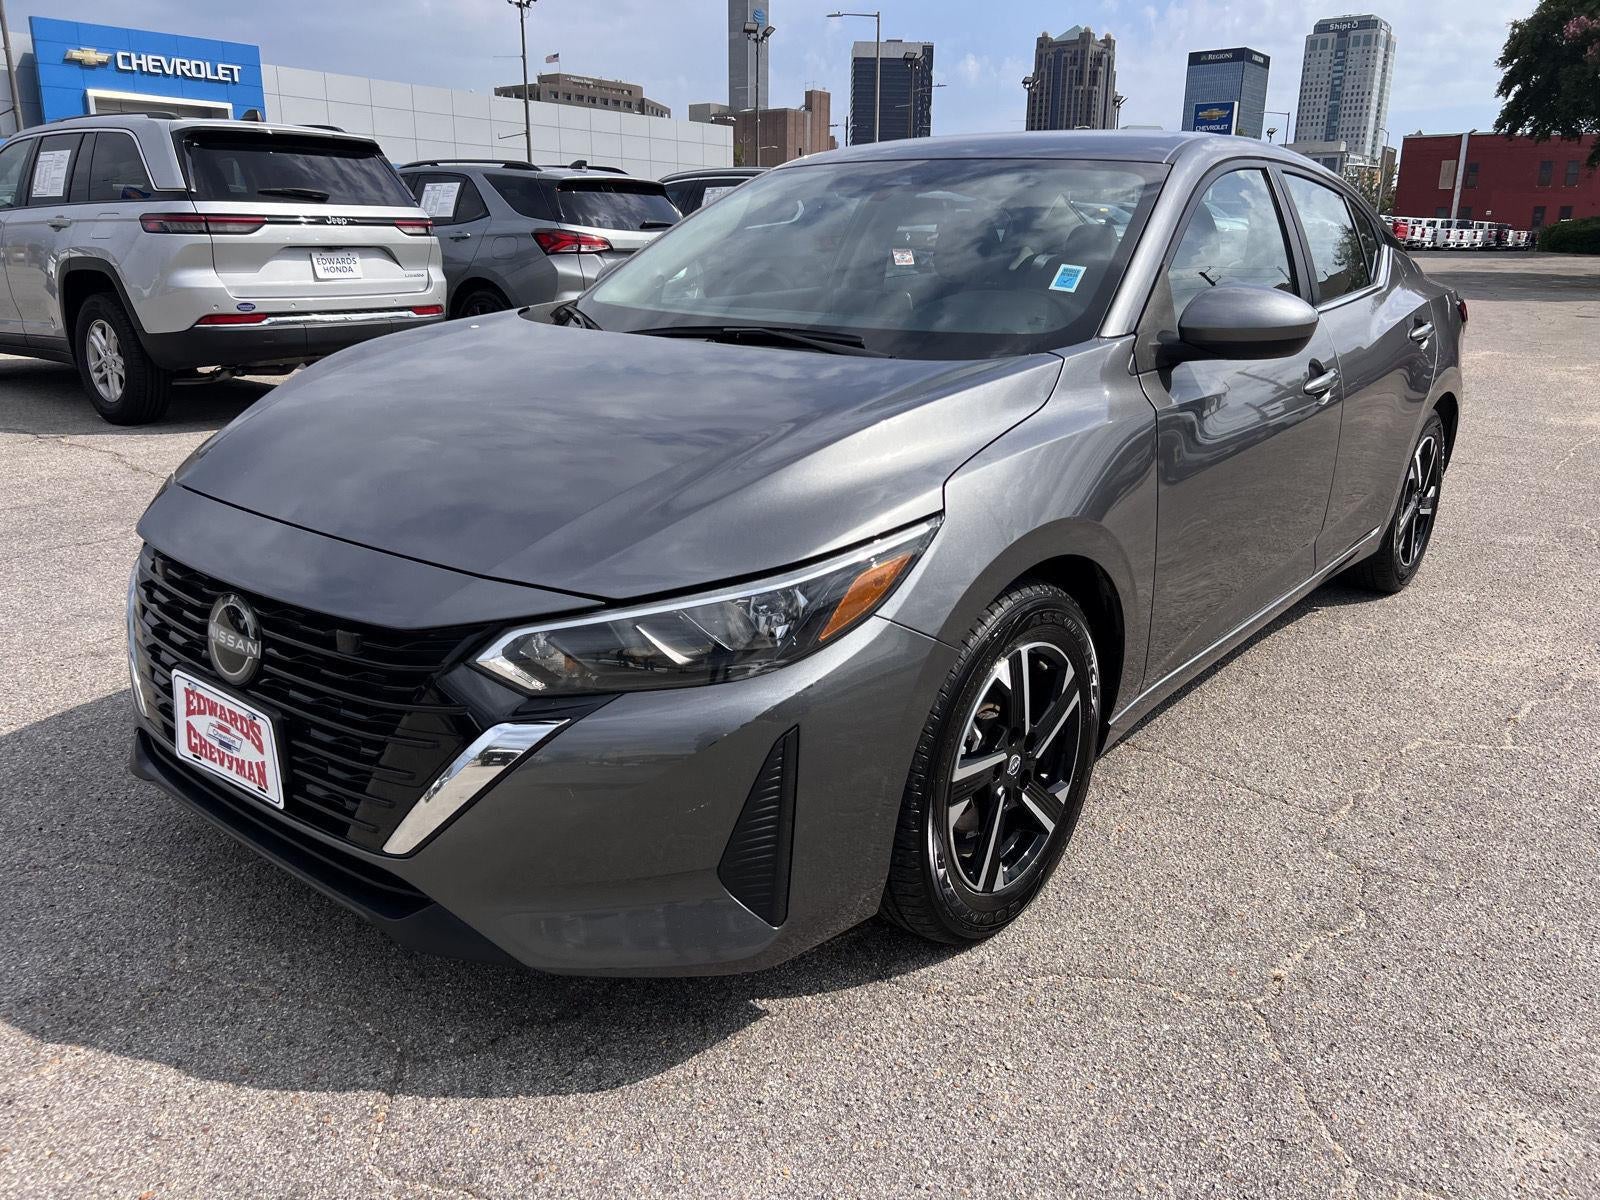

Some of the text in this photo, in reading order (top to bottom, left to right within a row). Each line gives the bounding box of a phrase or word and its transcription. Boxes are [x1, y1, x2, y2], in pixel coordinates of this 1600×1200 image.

[1207, 52, 1233, 61] REGIONS
[116, 51, 241, 83] CHEVROLET
[1195, 124, 1228, 132] CHEVROLET
[326, 216, 348, 225] Jeep
[316, 257, 357, 266] EDWARDS
[208, 625, 258, 655] NISSAN
[184, 687, 264, 756] EDWARDS
[186, 719, 269, 790] CHEVYMAN
